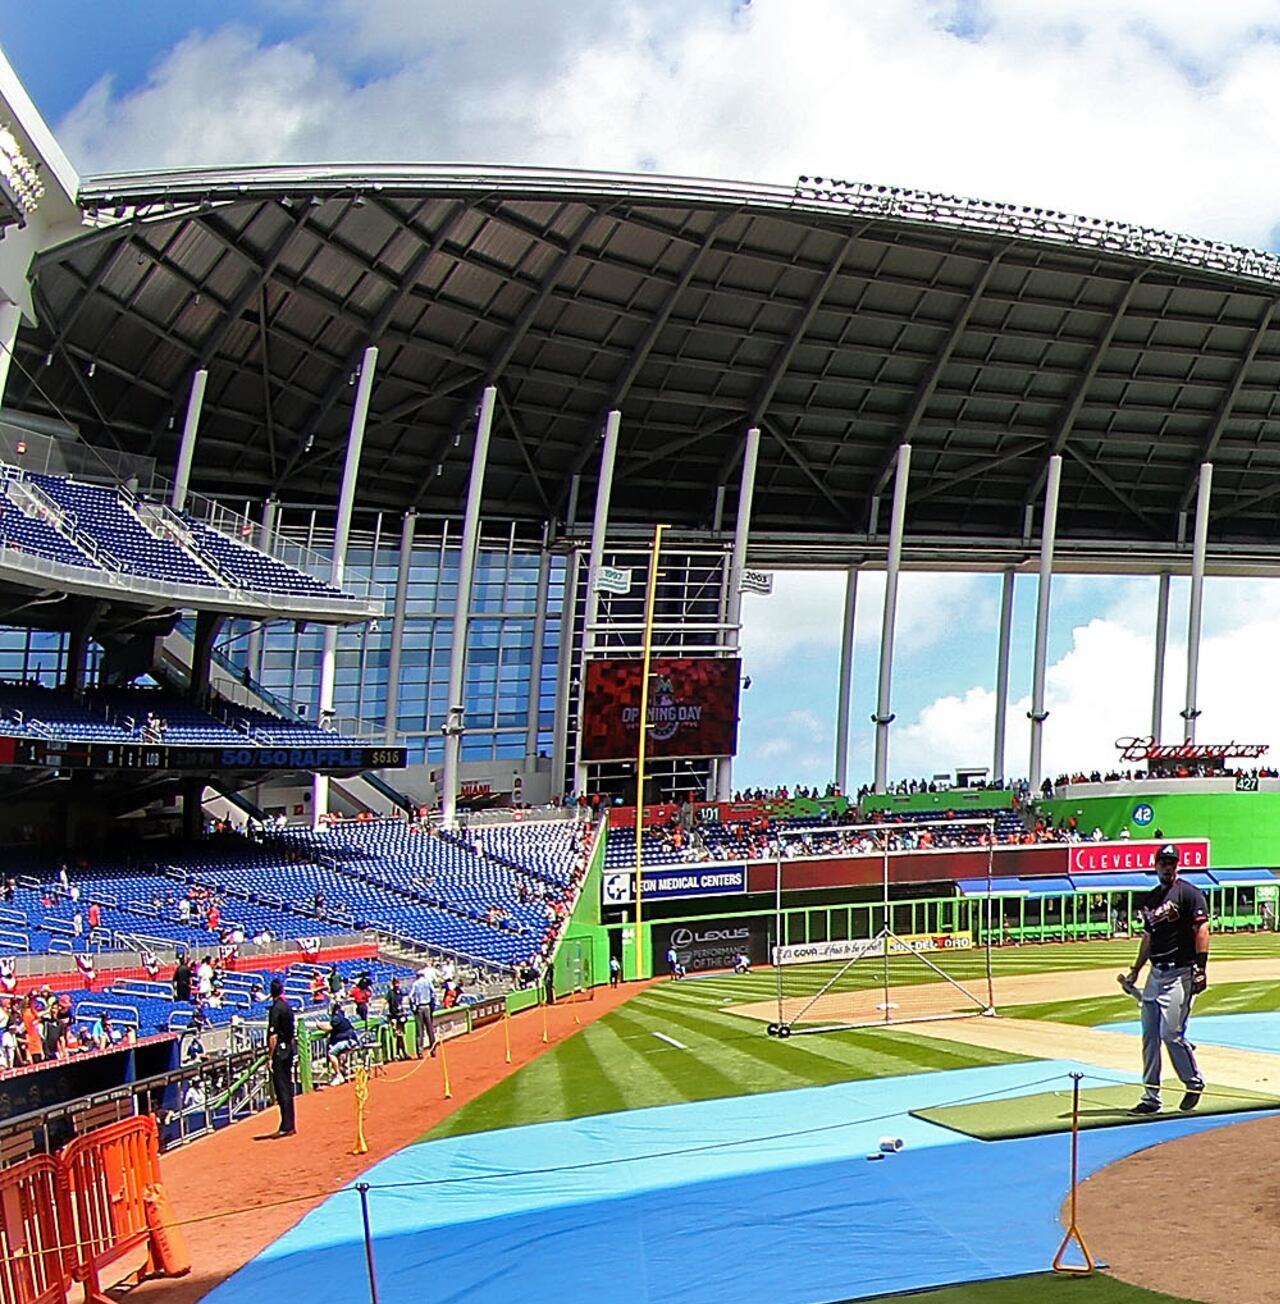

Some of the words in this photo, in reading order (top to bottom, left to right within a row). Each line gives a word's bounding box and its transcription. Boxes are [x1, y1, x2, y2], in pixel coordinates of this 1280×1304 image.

[745, 571, 767, 583] 2003
[621, 706, 677, 724] OPNING
[678, 706, 702, 721] DAY
[1115, 736, 1270, 763] Budweiser
[221, 748, 289, 766] 50/50
[290, 749, 363, 767] RAFFLE
[371, 750, 399, 765] $616
[1236, 778, 1257, 790] 427
[700, 807, 719, 821] 101
[1134, 807, 1151, 821] 42
[1076, 849, 1202, 869] CLEVELAER
[658, 876, 700, 892] MEDICAL
[701, 873, 742, 888] CENTERS
[694, 927, 750, 942] LEXUS
